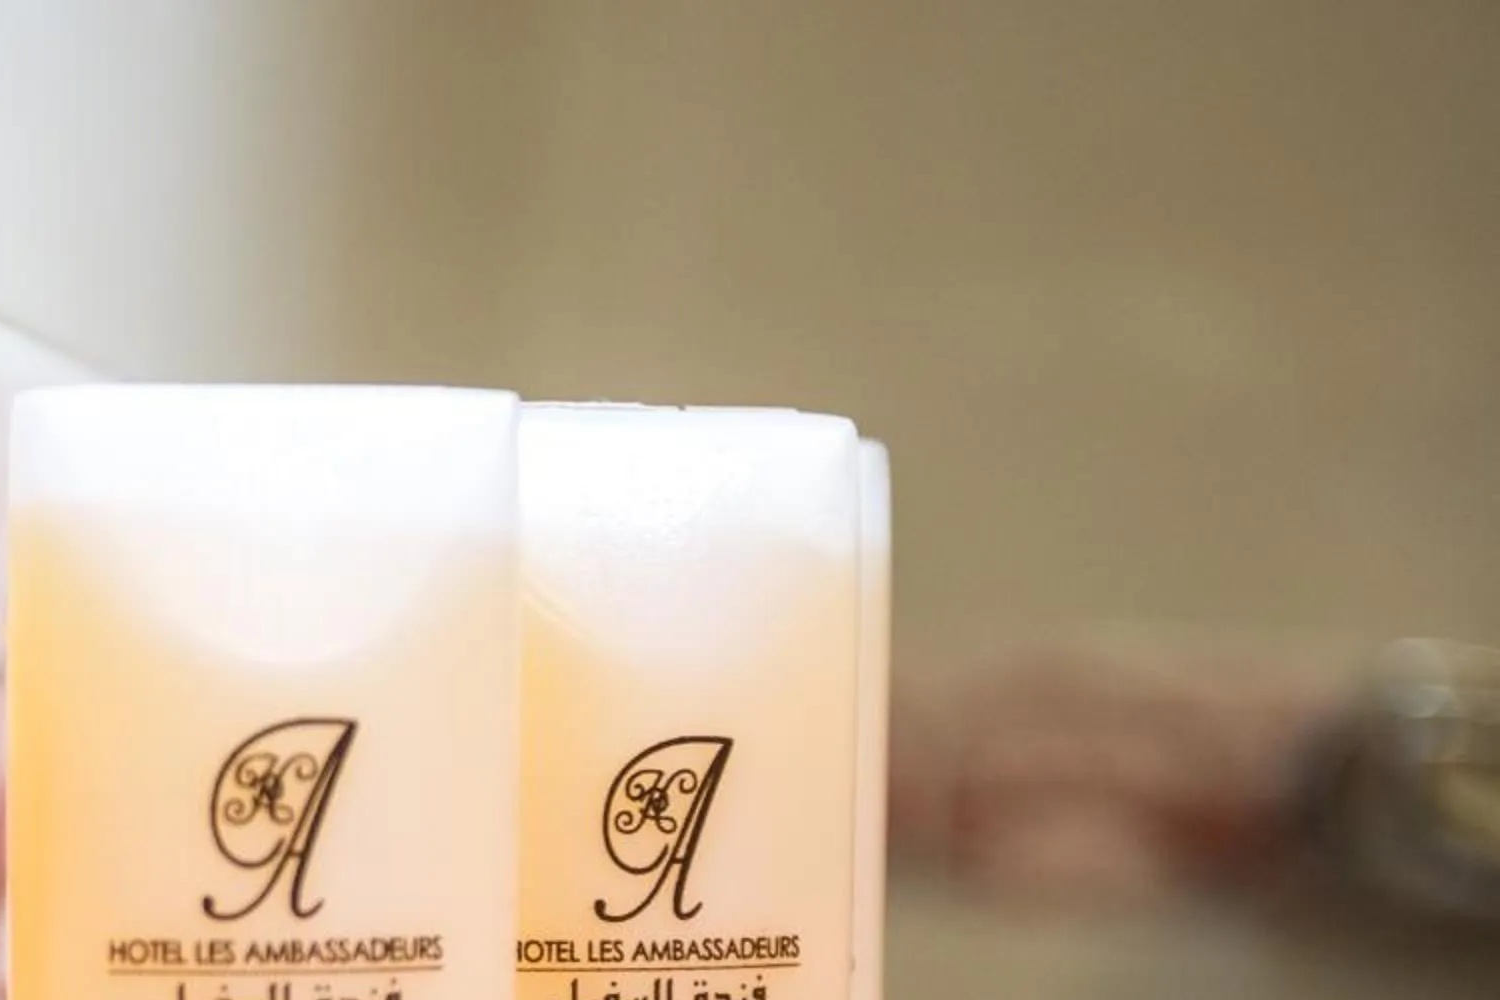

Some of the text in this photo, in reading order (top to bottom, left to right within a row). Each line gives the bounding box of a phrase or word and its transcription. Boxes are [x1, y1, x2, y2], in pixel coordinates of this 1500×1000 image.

[109, 936, 444, 965] HOTEL LES AMBASSADEURS
[587, 941, 625, 964] LES
[632, 936, 800, 961] AMBASSADEURS
